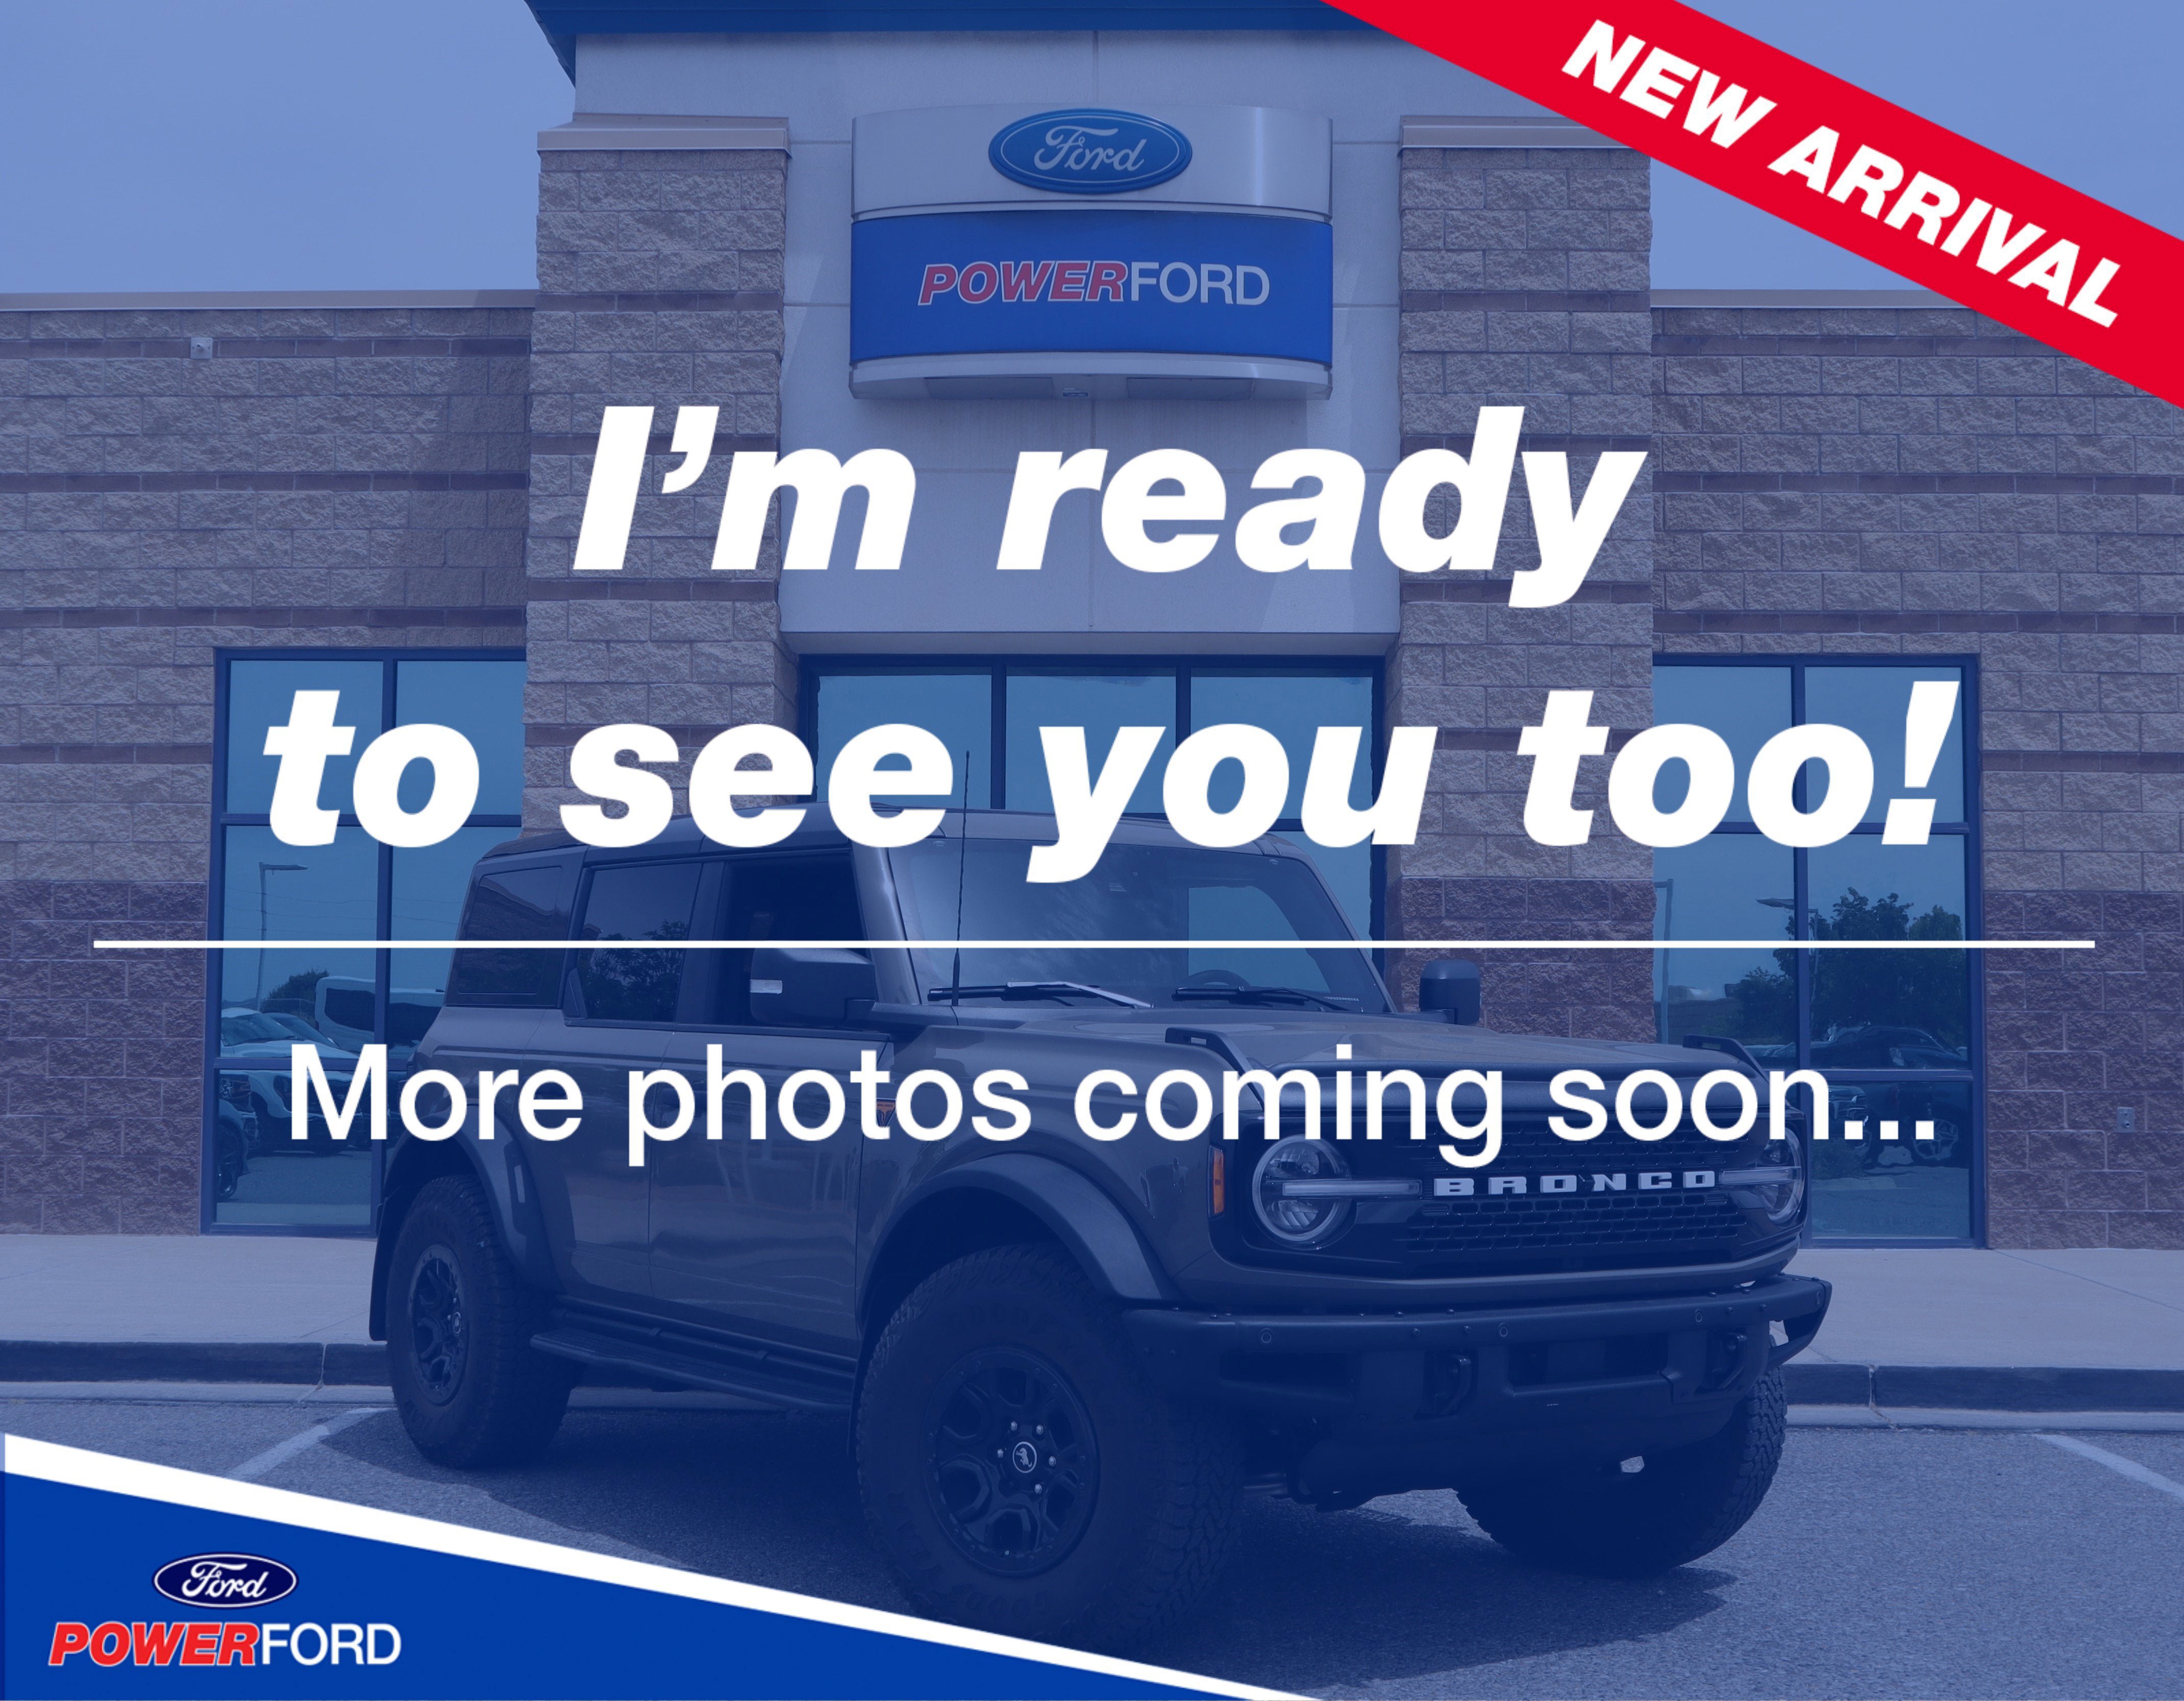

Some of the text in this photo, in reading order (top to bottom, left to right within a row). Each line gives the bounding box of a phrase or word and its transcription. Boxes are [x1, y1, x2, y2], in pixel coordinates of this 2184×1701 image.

[1033, 125, 1147, 171] Ford
[917, 260, 1271, 306] POWERFORD
[1433, 1170, 1715, 1196] BRONCO
